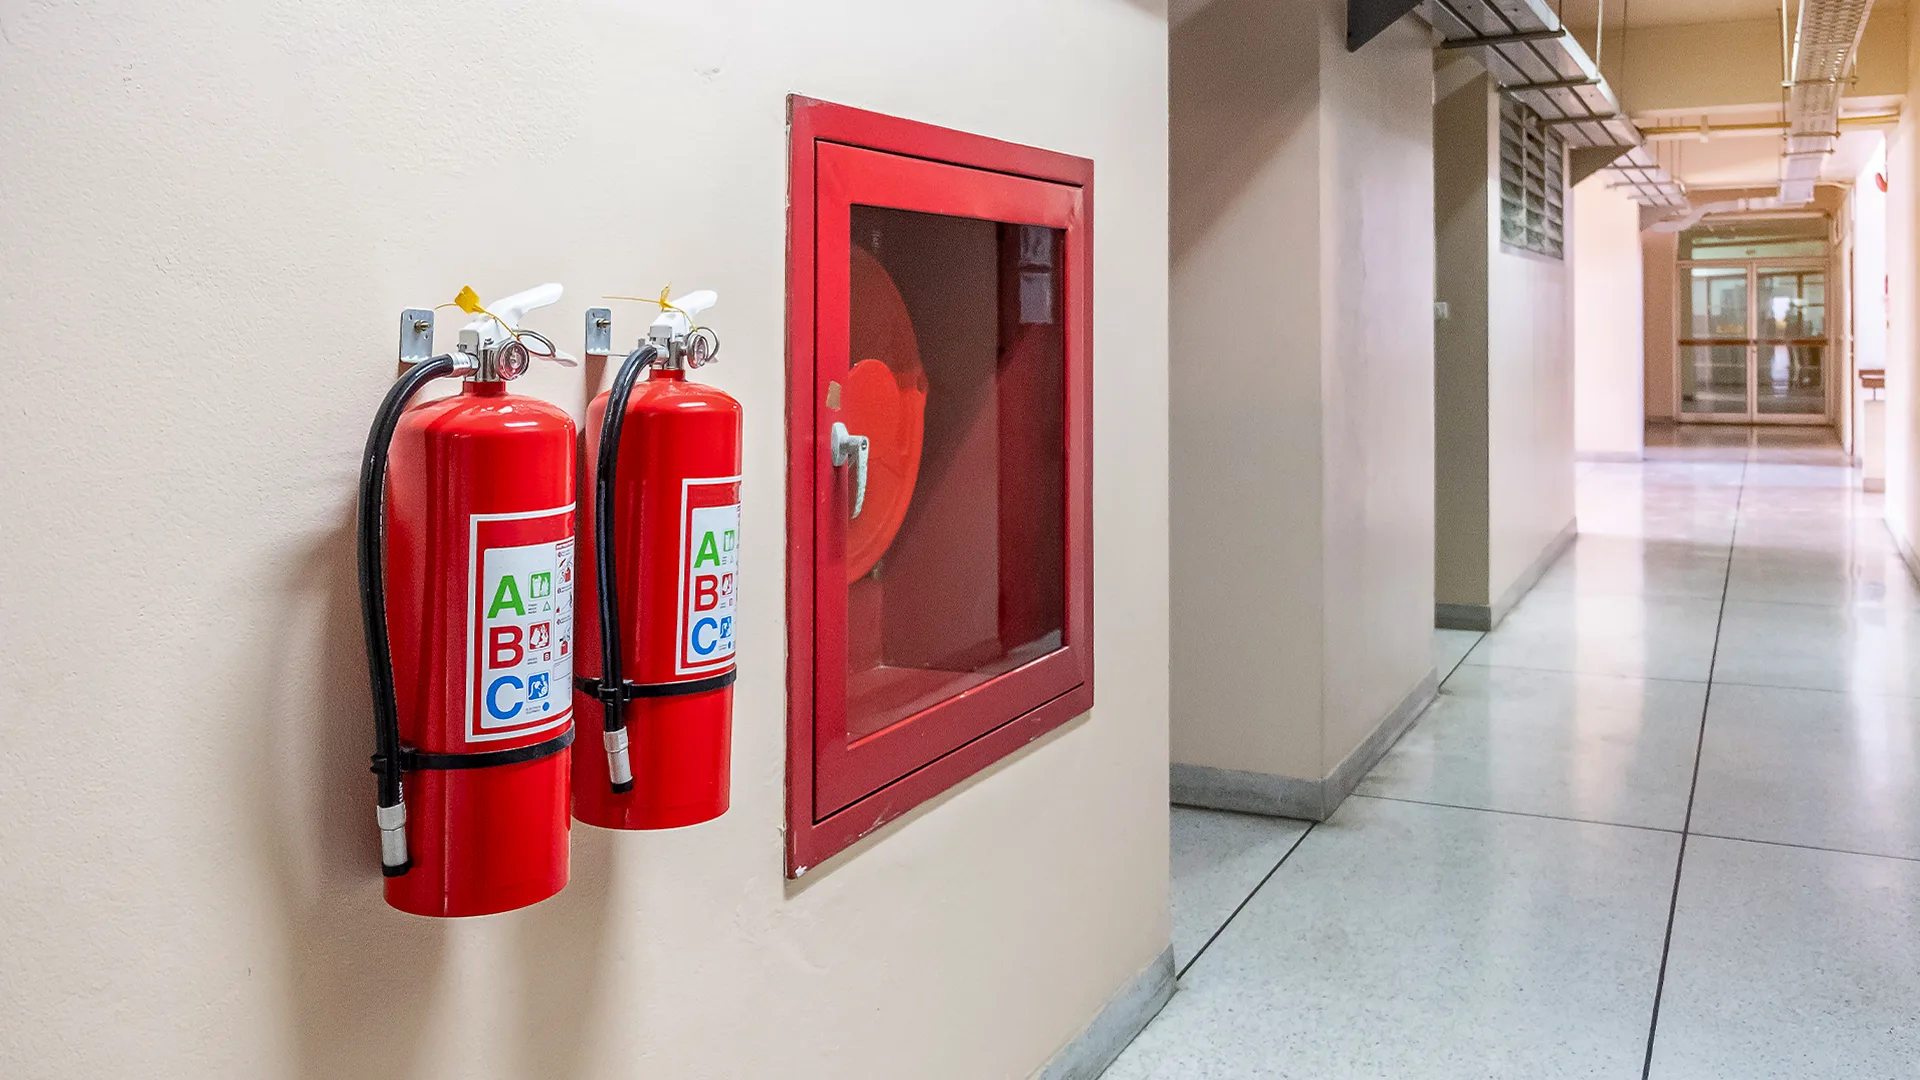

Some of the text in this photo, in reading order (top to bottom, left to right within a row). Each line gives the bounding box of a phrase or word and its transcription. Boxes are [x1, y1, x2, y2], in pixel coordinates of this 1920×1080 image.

[694, 531, 721, 568] A
[487, 575, 526, 618] A
[695, 575, 719, 612] B
[488, 626, 524, 670] B
[691, 617, 719, 656] C
[486, 675, 524, 720] C
